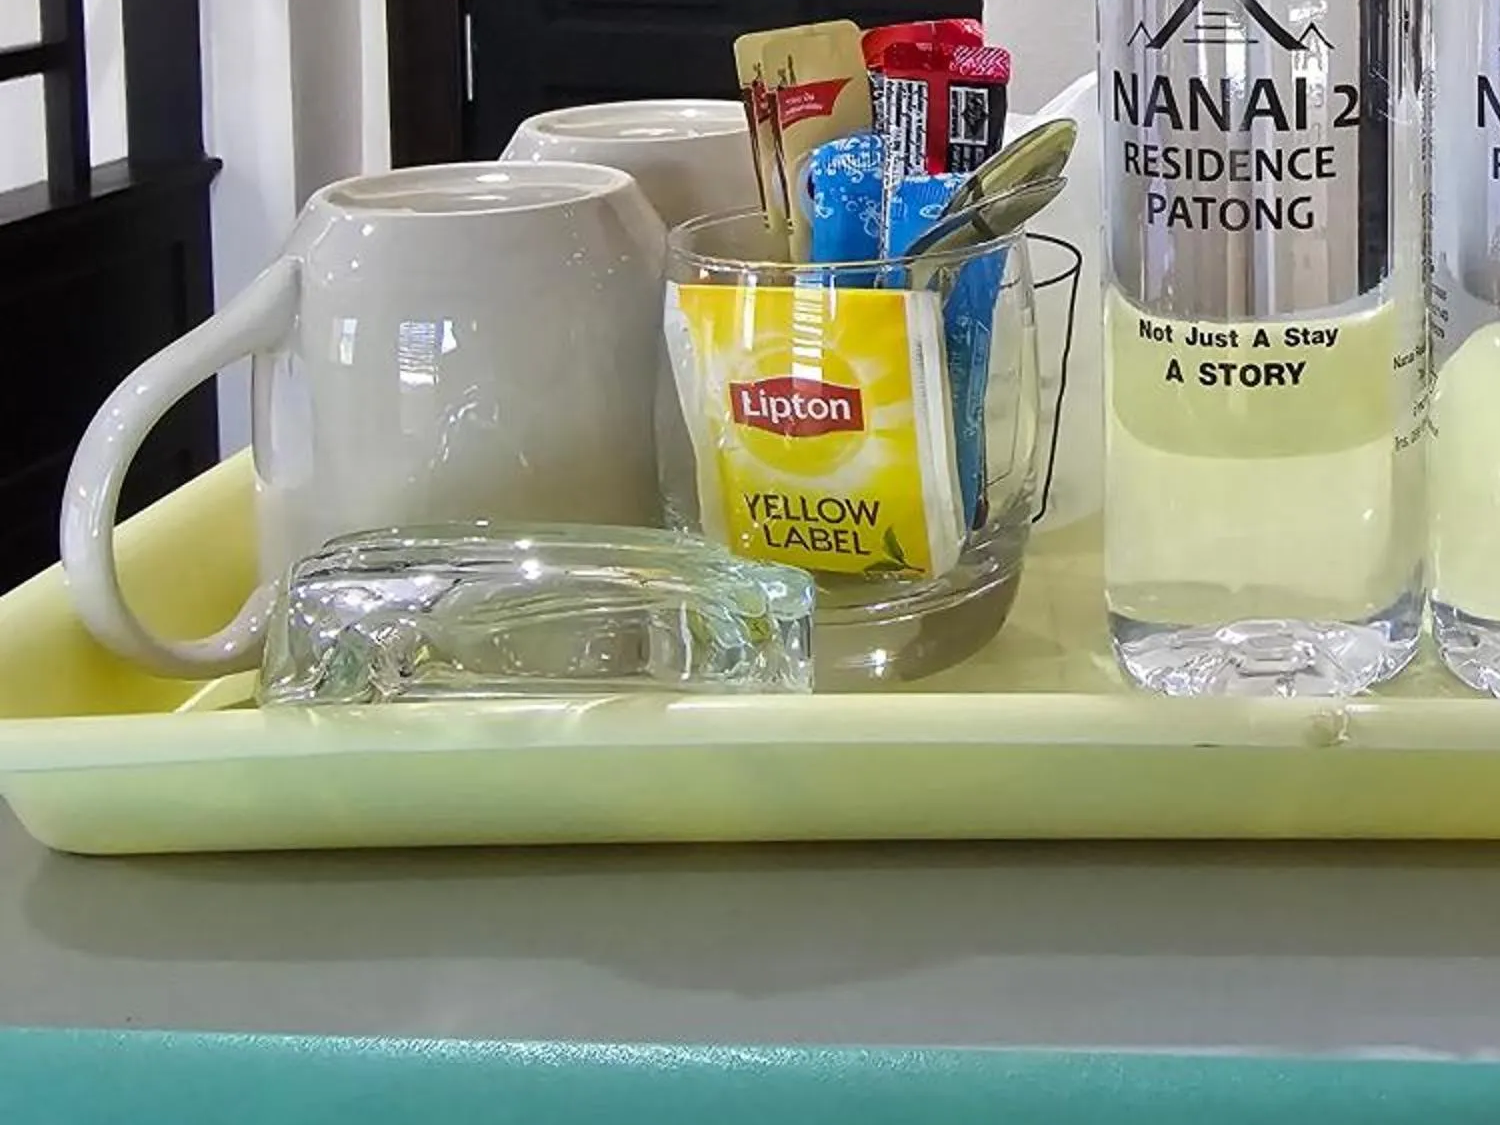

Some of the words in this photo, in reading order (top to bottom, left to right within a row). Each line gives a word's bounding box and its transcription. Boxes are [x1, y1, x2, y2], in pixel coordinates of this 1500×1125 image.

[1113, 71, 1307, 132] NANAI
[1333, 85, 1360, 127] 2
[1124, 141, 1337, 182] RESIDENCE
[1147, 194, 1314, 231] PATONG
[1139, 319, 1172, 343] Not
[1185, 327, 1239, 348] Just
[1252, 328, 1270, 347] A
[1285, 325, 1339, 348] Stay
[1166, 359, 1184, 382] A
[1198, 362, 1306, 387] STORY
[742, 389, 851, 423] Lipton
[745, 493, 879, 526] YELLOW
[764, 523, 871, 555] LABEL
